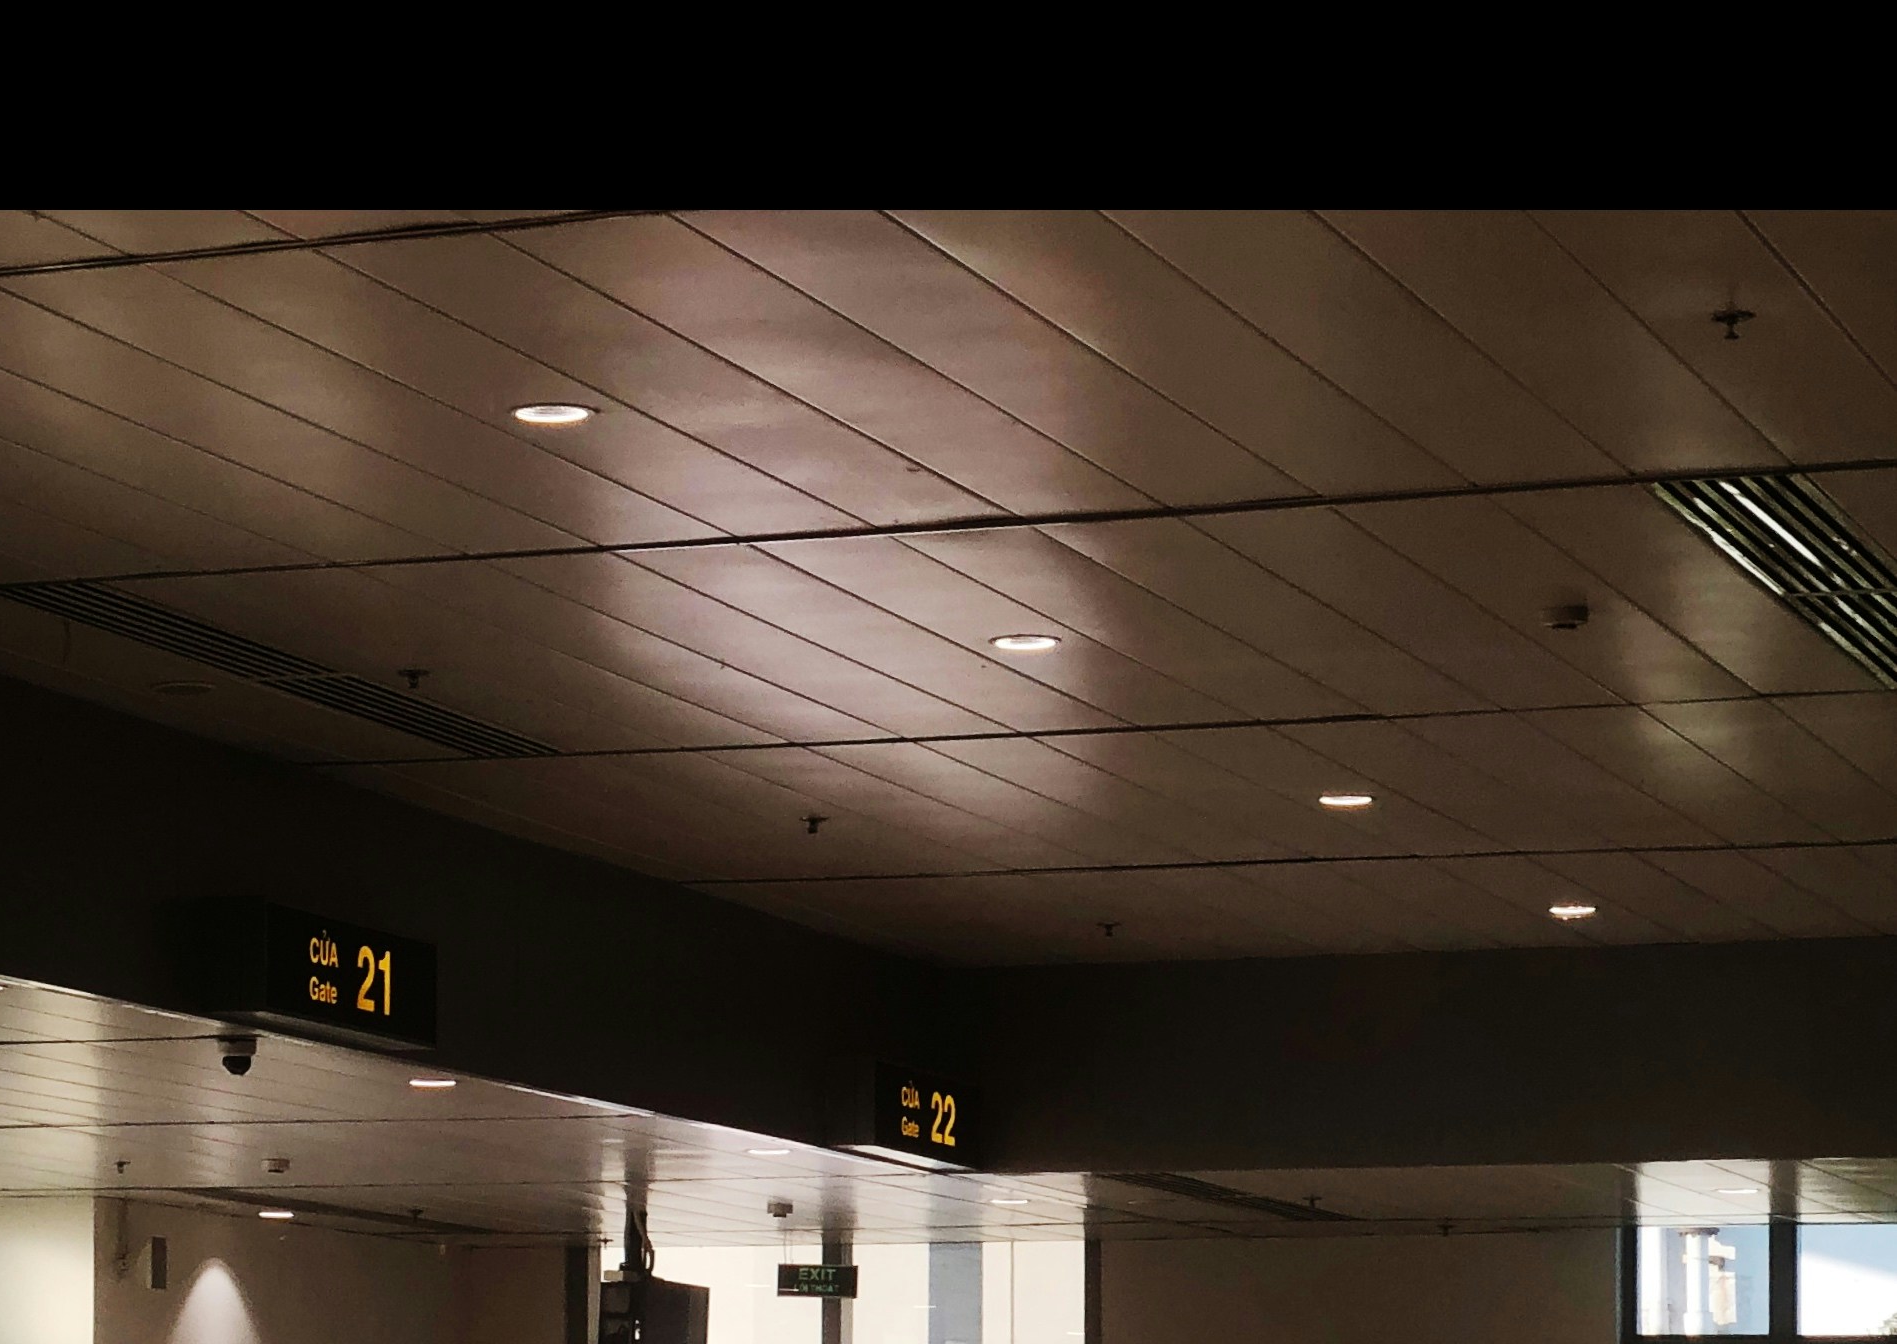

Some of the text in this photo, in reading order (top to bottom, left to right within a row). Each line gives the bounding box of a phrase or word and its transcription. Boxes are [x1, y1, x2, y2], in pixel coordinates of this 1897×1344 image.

[309, 976, 338, 1004] Gate
[357, 945, 391, 1016] 21
[931, 1091, 956, 1147] 22
[799, 1267, 836, 1281] EXIT
